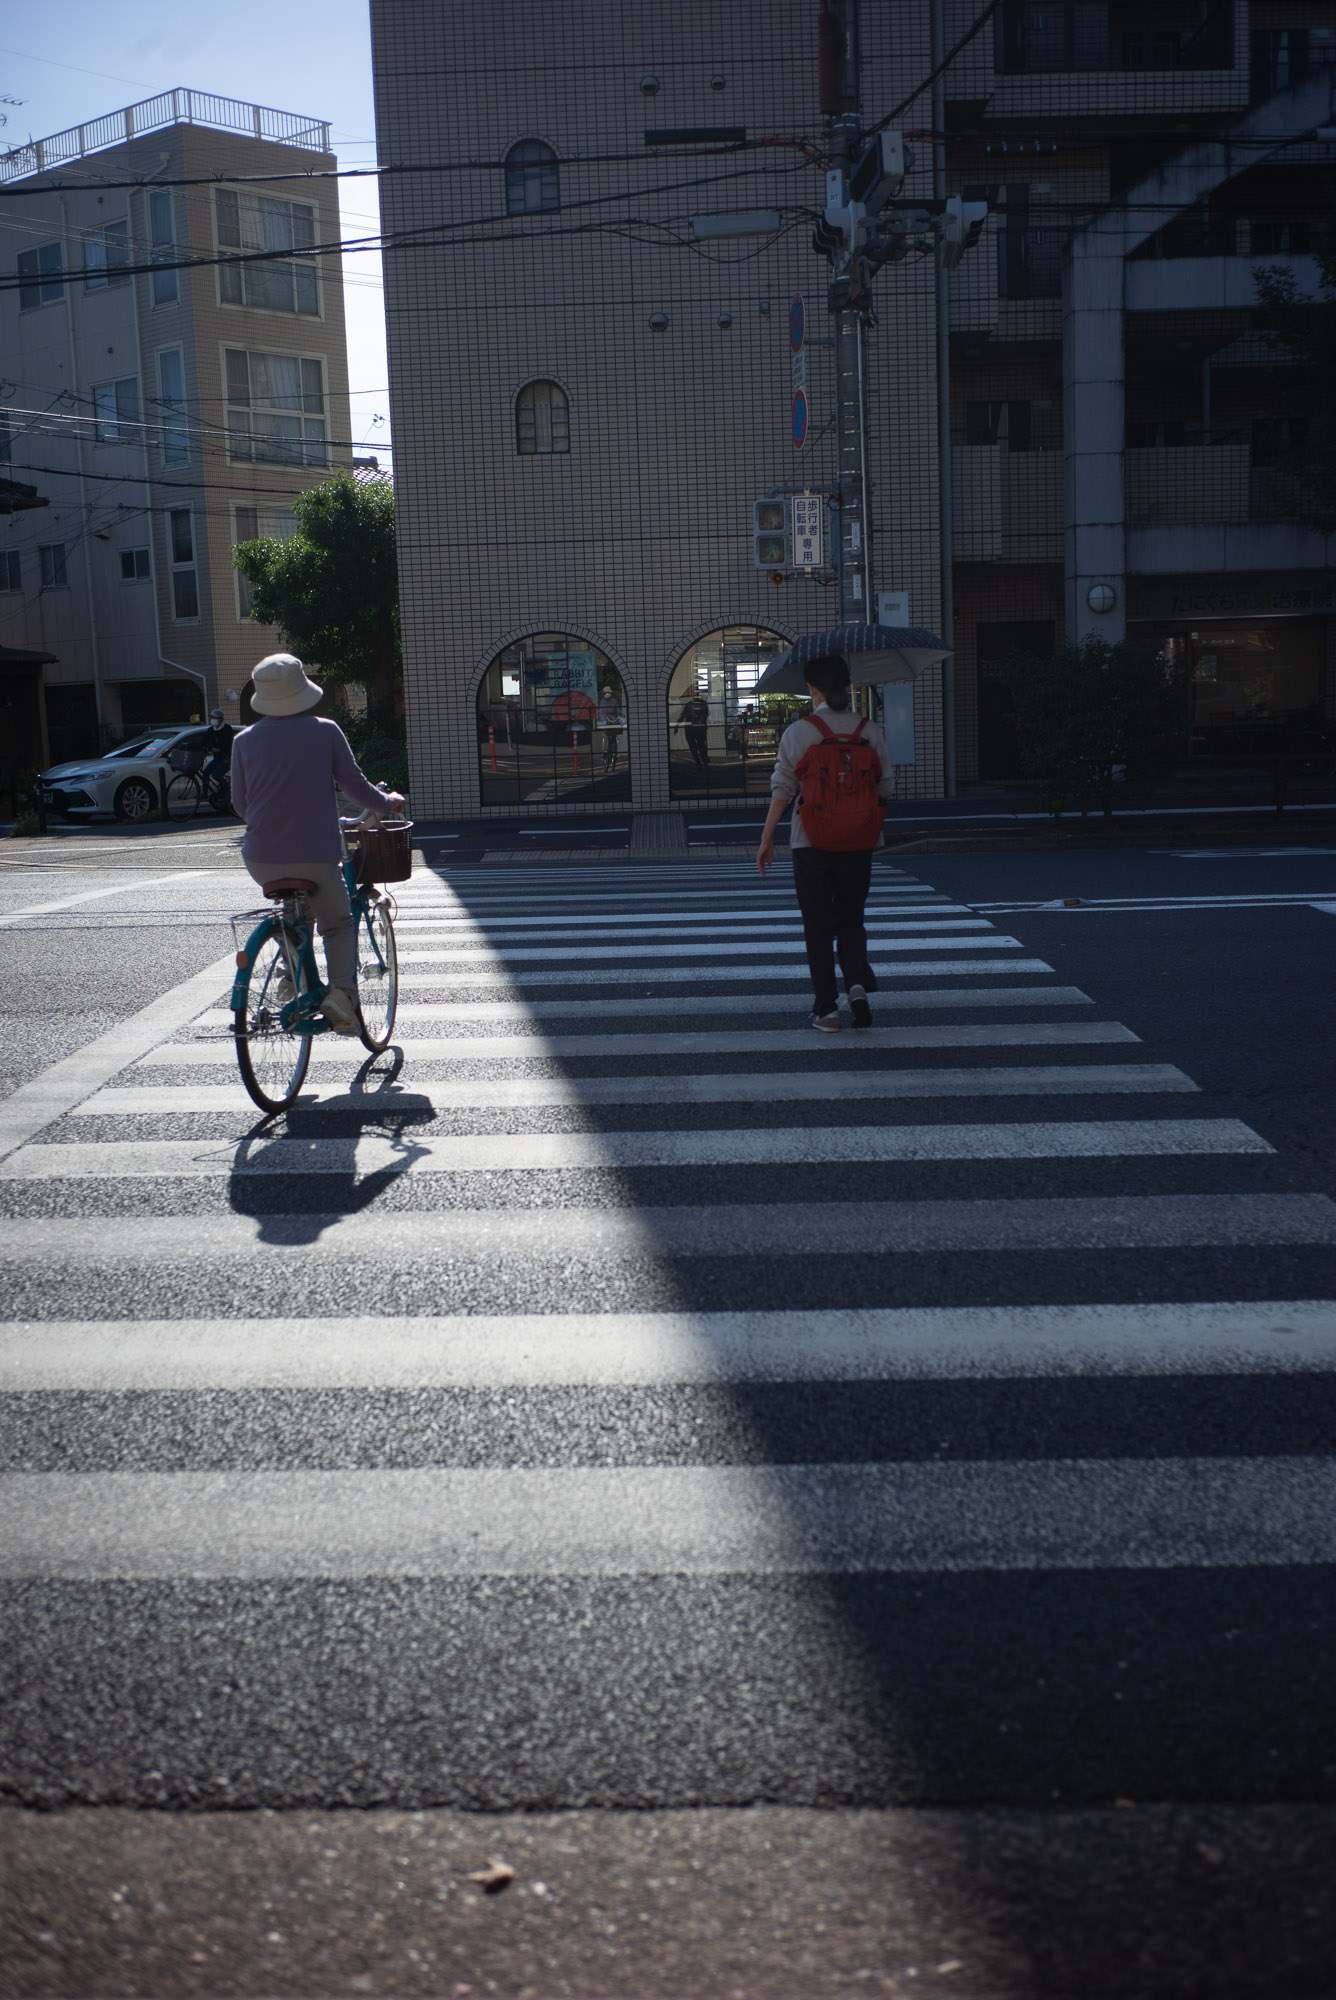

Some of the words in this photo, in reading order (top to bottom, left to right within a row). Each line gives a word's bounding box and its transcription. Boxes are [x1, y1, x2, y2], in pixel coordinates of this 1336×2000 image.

[796, 501, 806, 536] 自転車
[807, 500, 818, 536] 歩行者
[802, 538, 813, 562] 専用
[554, 669, 592, 679] RABBIT
[554, 679, 593, 688] BAGELS
